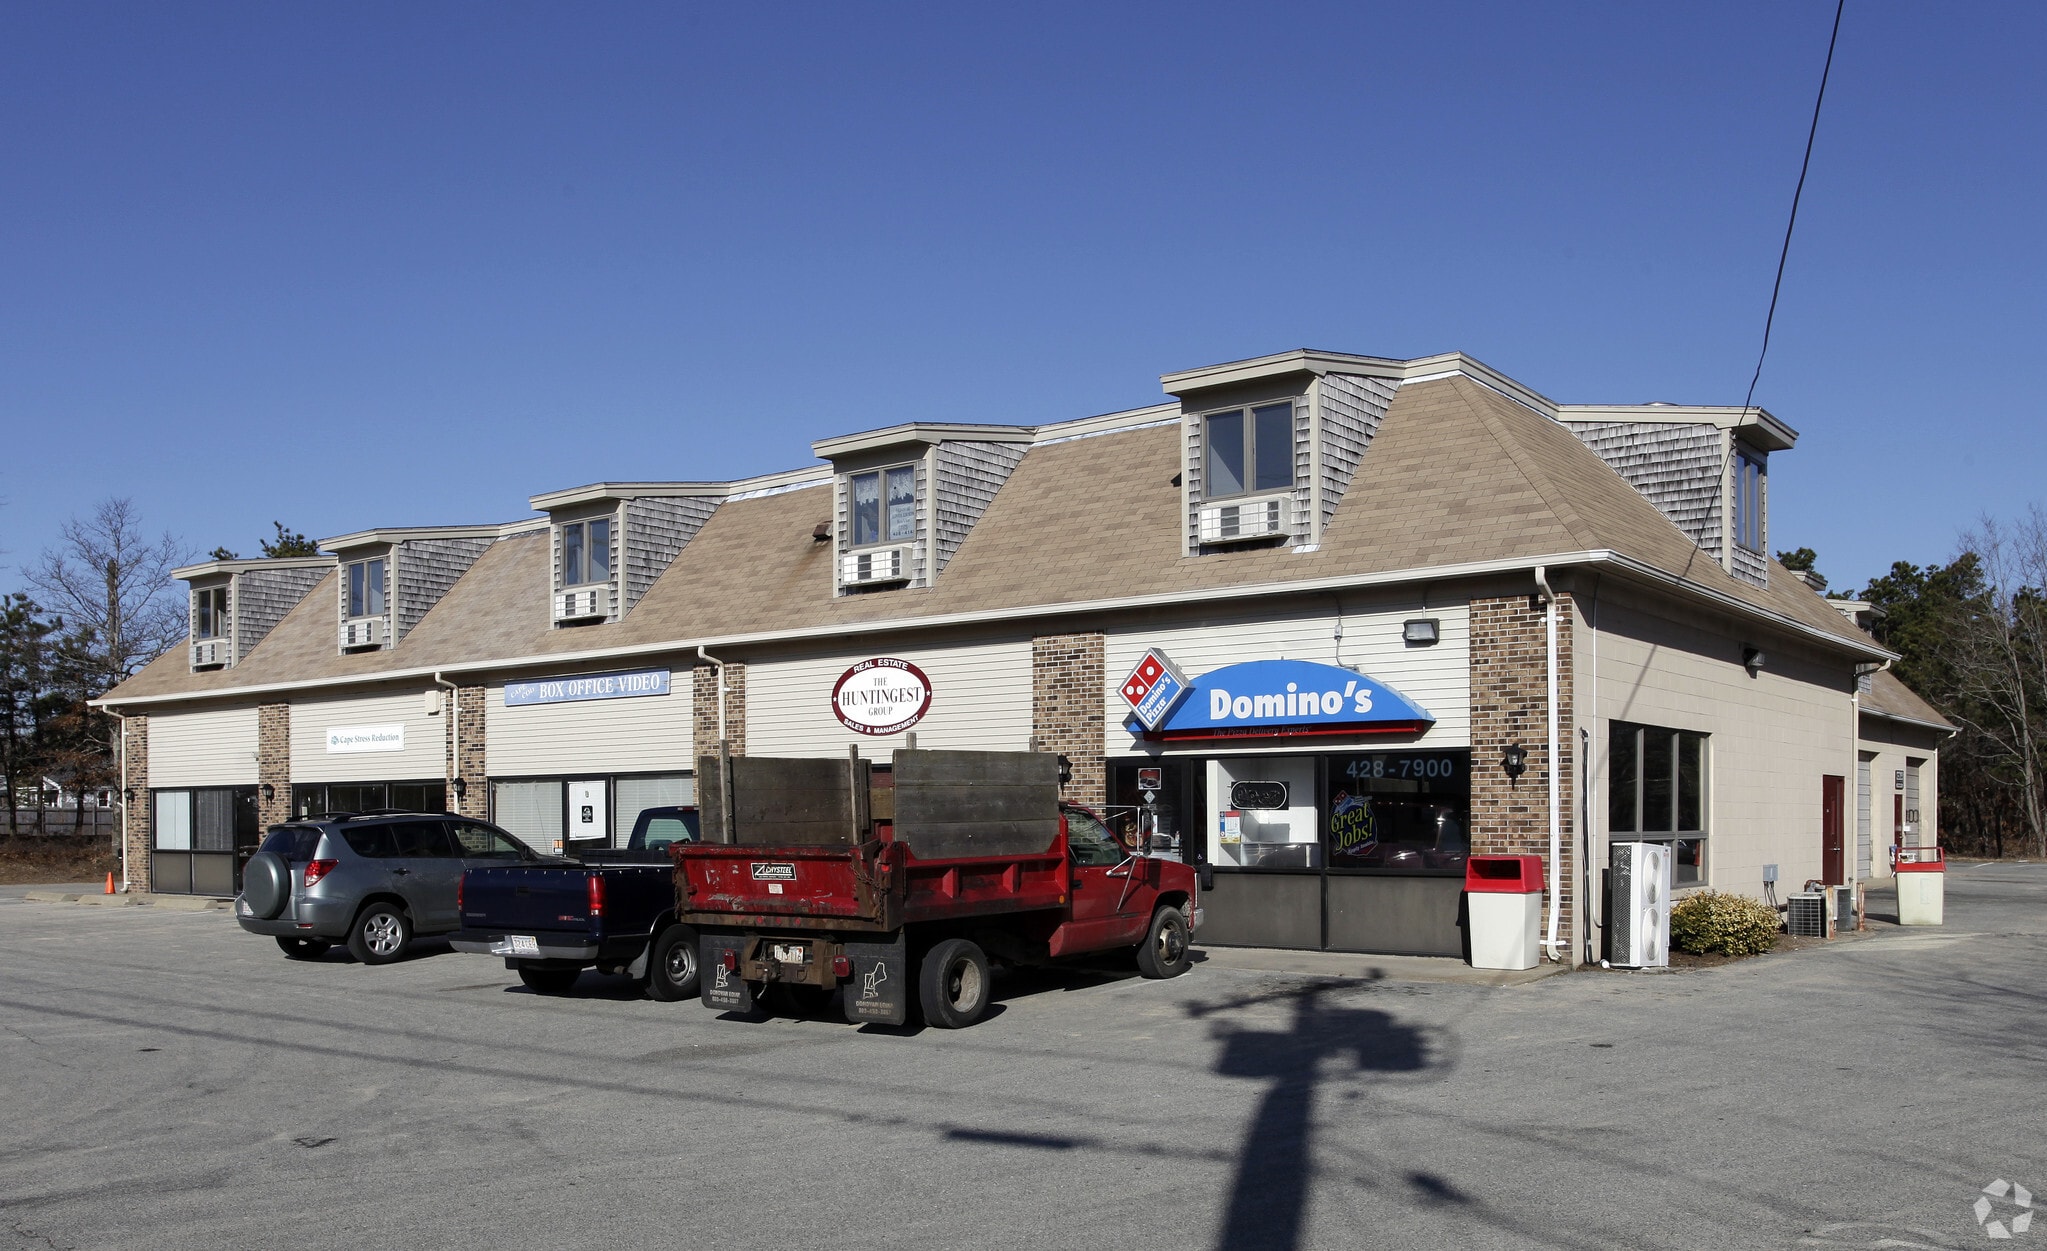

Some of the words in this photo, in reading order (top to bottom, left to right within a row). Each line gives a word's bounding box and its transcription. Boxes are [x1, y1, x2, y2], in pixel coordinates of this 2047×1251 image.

[854, 661, 875, 673] REAL
[878, 659, 908, 670] ESTATE
[539, 682, 565, 699] BOX
[568, 678, 614, 696] OFFICE
[618, 674, 660, 692] VIDEO
[873, 677, 887, 686] THE
[842, 687, 921, 706] HUNTINGEST
[1139, 676, 1171, 714] Domino's
[1210, 681, 1373, 720] Domino's
[868, 706, 893, 716] GROUP
[1145, 698, 1167, 722] Pizza
[843, 718, 864, 732] SALES
[874, 715, 919, 734] MANAGEMENT
[340, 735, 353, 745] Cape
[354, 735, 370, 743] Stress
[371, 733, 400, 742] Reduction
[1346, 759, 1453, 778] 428-7900
[1331, 802, 1370, 832] Great
[1336, 817, 1373, 850] Jobs!
